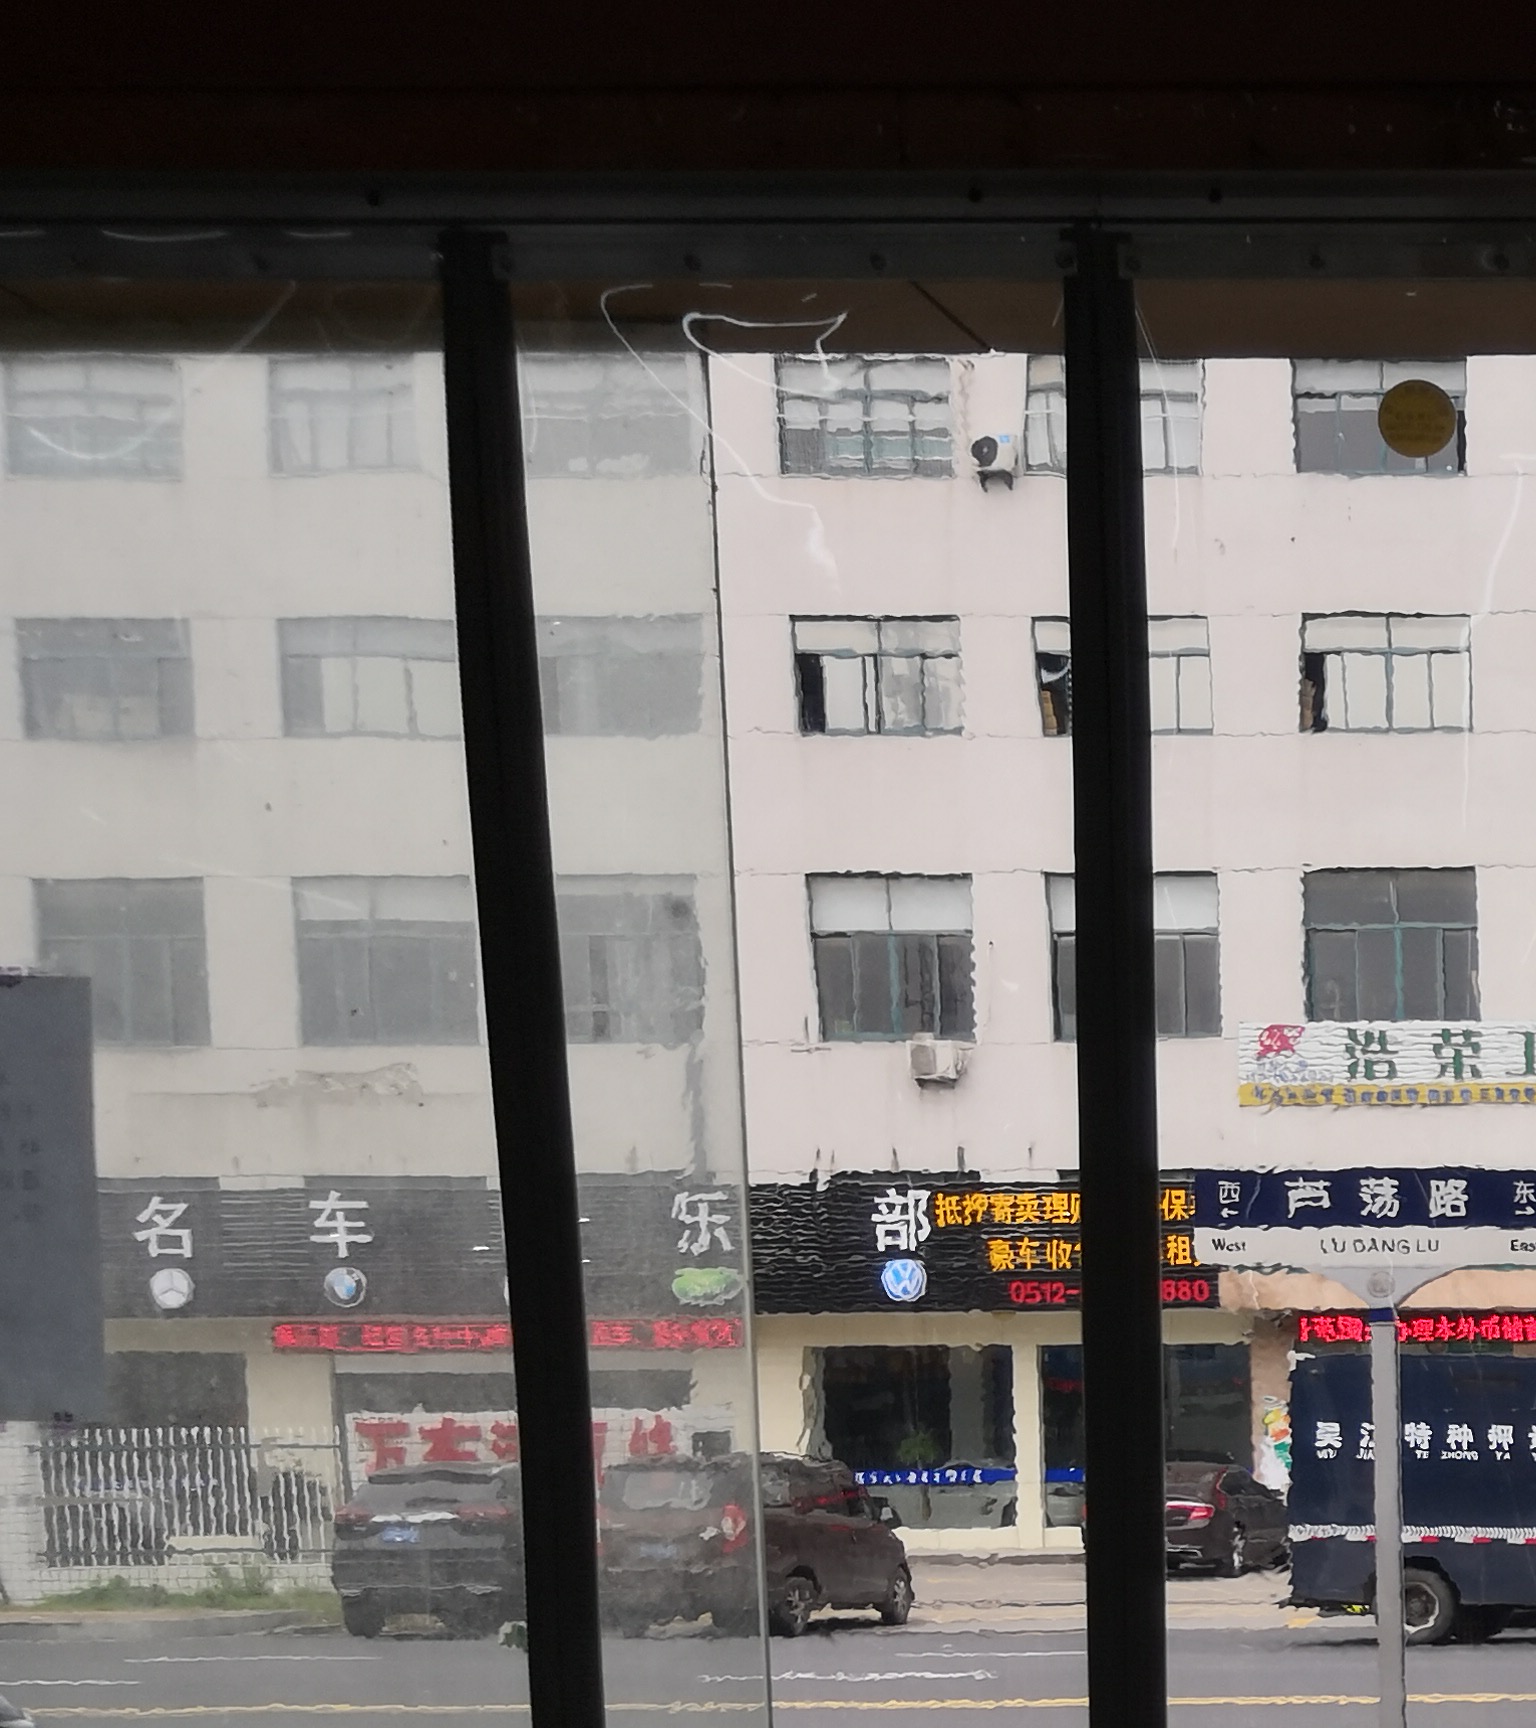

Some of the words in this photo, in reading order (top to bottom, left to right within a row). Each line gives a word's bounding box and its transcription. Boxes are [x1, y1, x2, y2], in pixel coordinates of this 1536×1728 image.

[1218, 1181, 1240, 1204] 西
[1285, 1178, 1468, 1219] 芦荡路
[1512, 1180, 1536, 1204] 东
[1212, 1239, 1246, 1253] West
[1008, 1279, 1210, 1304] 0512-880
[1356, 1450, 1375, 1460] JIA
